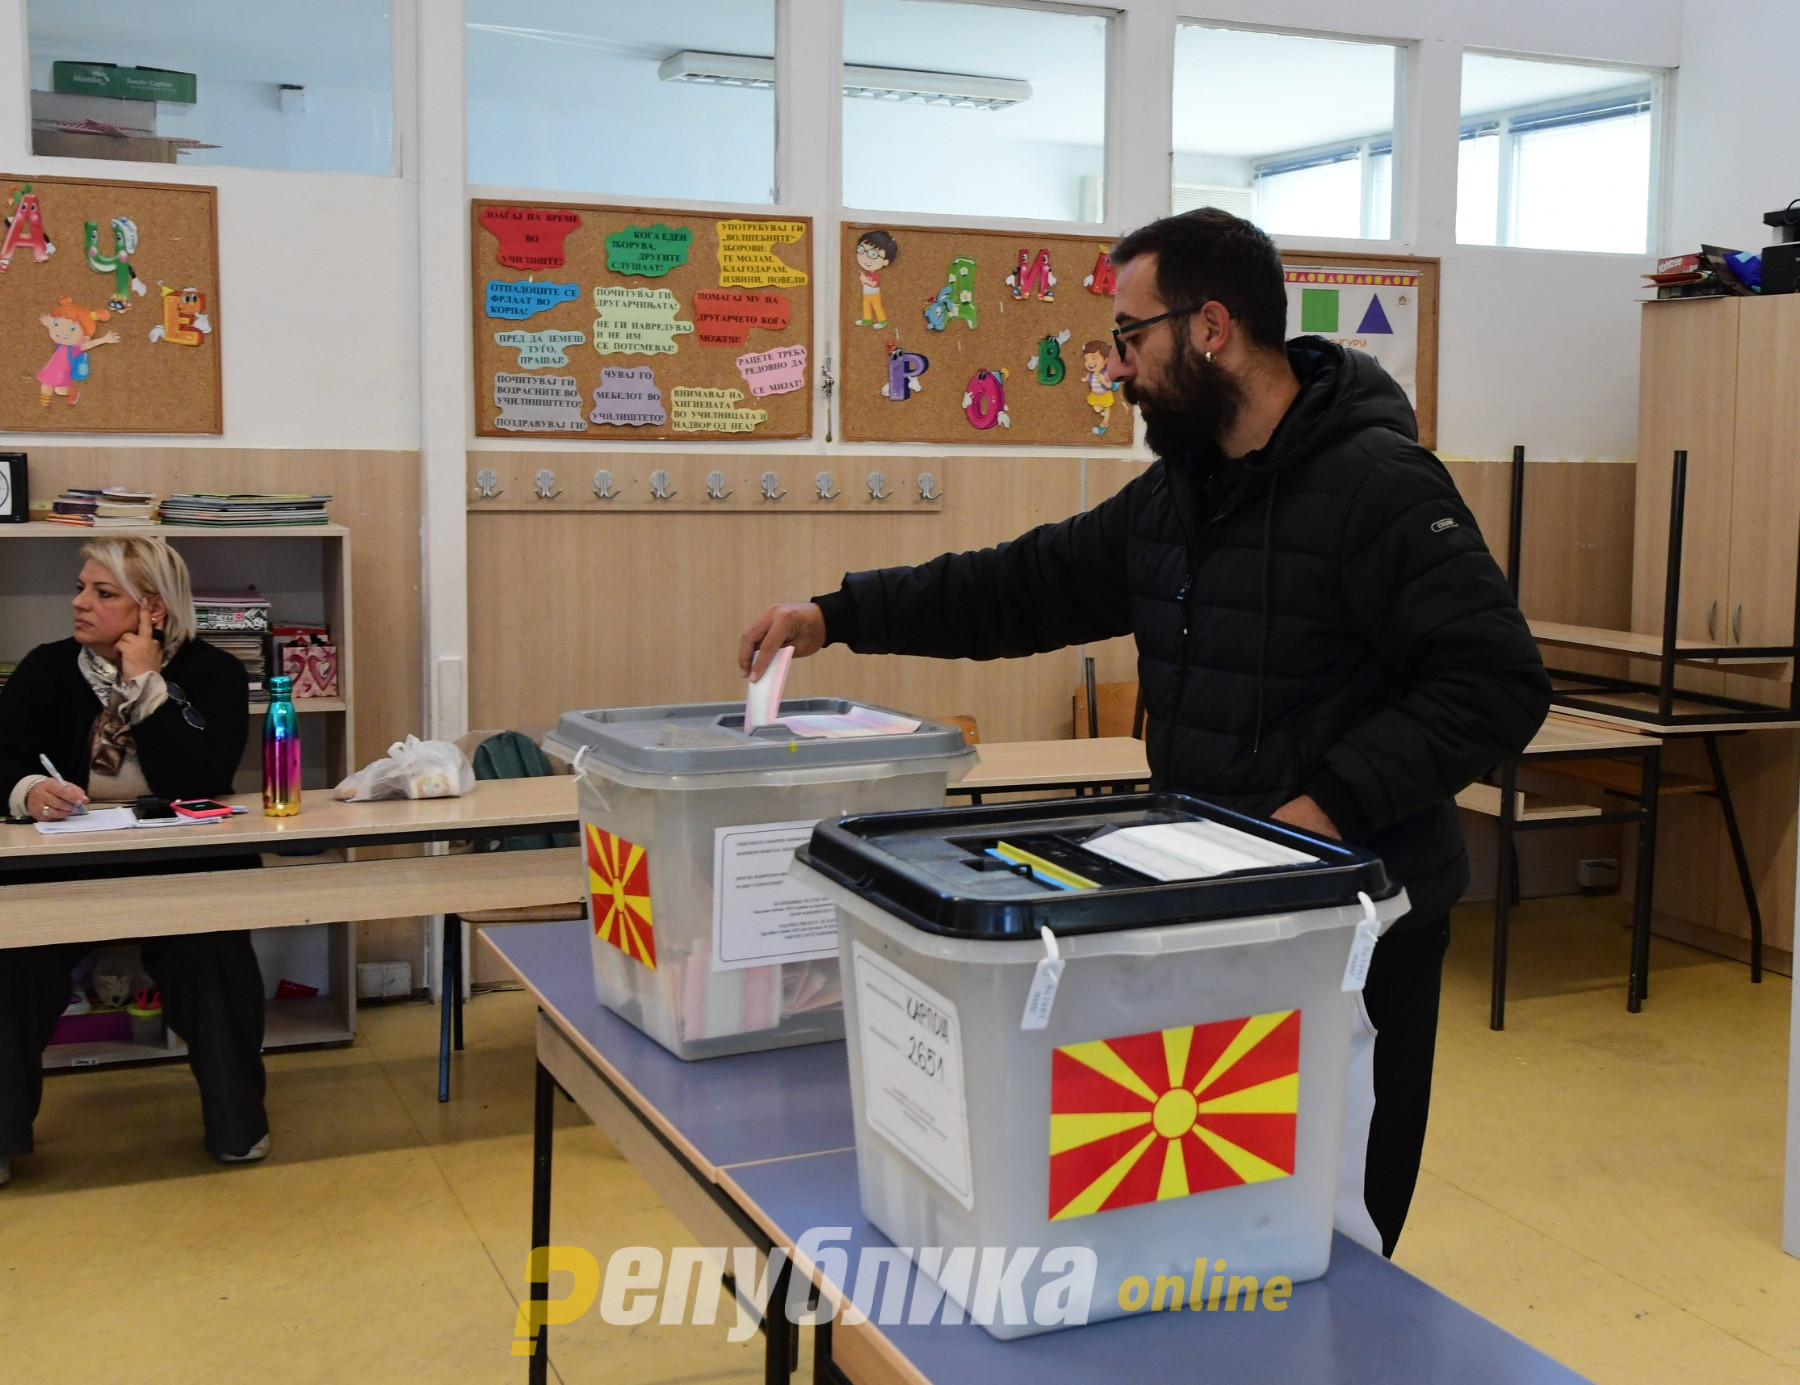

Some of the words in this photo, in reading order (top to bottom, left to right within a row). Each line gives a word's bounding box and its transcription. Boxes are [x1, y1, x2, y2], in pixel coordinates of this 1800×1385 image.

[721, 223, 787, 232] УПОТРЕБУВАЈ
[791, 224, 803, 232] ГИ
[525, 235, 539, 243] ВО
[633, 231, 660, 240] КОГА
[662, 233, 687, 242] ЕДЕН
[638, 253, 682, 263] ДРУГИТЕ
[722, 254, 734, 263] ТЕ
[490, 284, 560, 297] ОТПАДОЦИТЕ
[564, 289, 577, 297] СЕ
[596, 288, 654, 299] ПОЧИТУВАЈ
[659, 291, 671, 300] ГИ
[536, 298, 550, 306] ВО
[698, 292, 742, 302] ПОМАГАЈ
[746, 295, 760, 303] МУ
[697, 313, 757, 324] ДРУГАРЧЕТО
[761, 316, 786, 325] КОГА
[596, 320, 610, 329] НЕ
[614, 321, 627, 329] ГИ
[631, 322, 692, 332] НАВРЕДУВАЈ
[499, 334, 525, 343] ПРЕД
[529, 335, 543, 343] ДА
[549, 335, 583, 343] ЗЕМЕШ
[608, 332, 621, 340] НЕ
[625, 332, 642, 340] ИМ
[596, 342, 609, 350] СЕ
[738, 353, 774, 366] РАЦЕТЕ
[777, 348, 806, 359] ТРЕБА
[744, 362, 788, 375] РЕДОВНО
[790, 359, 804, 368] ДА
[604, 370, 635, 379] ЧУВАЈ
[639, 372, 652, 380] ГО
[497, 375, 557, 386] ПОЧИТУВАЈ
[561, 379, 574, 387] ГИ
[497, 386, 562, 397] ВОЗРАСНИТЕ
[564, 389, 578, 398] ВО
[674, 389, 725, 398] ВНИМАВАЈ
[729, 391, 742, 399] НА
[752, 386, 765, 395] СЕ
[596, 391, 643, 400] МЕБЕЛОТ
[647, 393, 660, 401] ВО
[674, 400, 731, 409] ХИГИЕНАТА
[674, 410, 687, 418] ВО
[691, 411, 756, 420] УЧИЛНИЦАТА
[496, 418, 565, 429] ПОЗДРАВУВАЈ
[674, 421, 712, 429] НАДВОР
[713, 422, 727, 430] ОД
